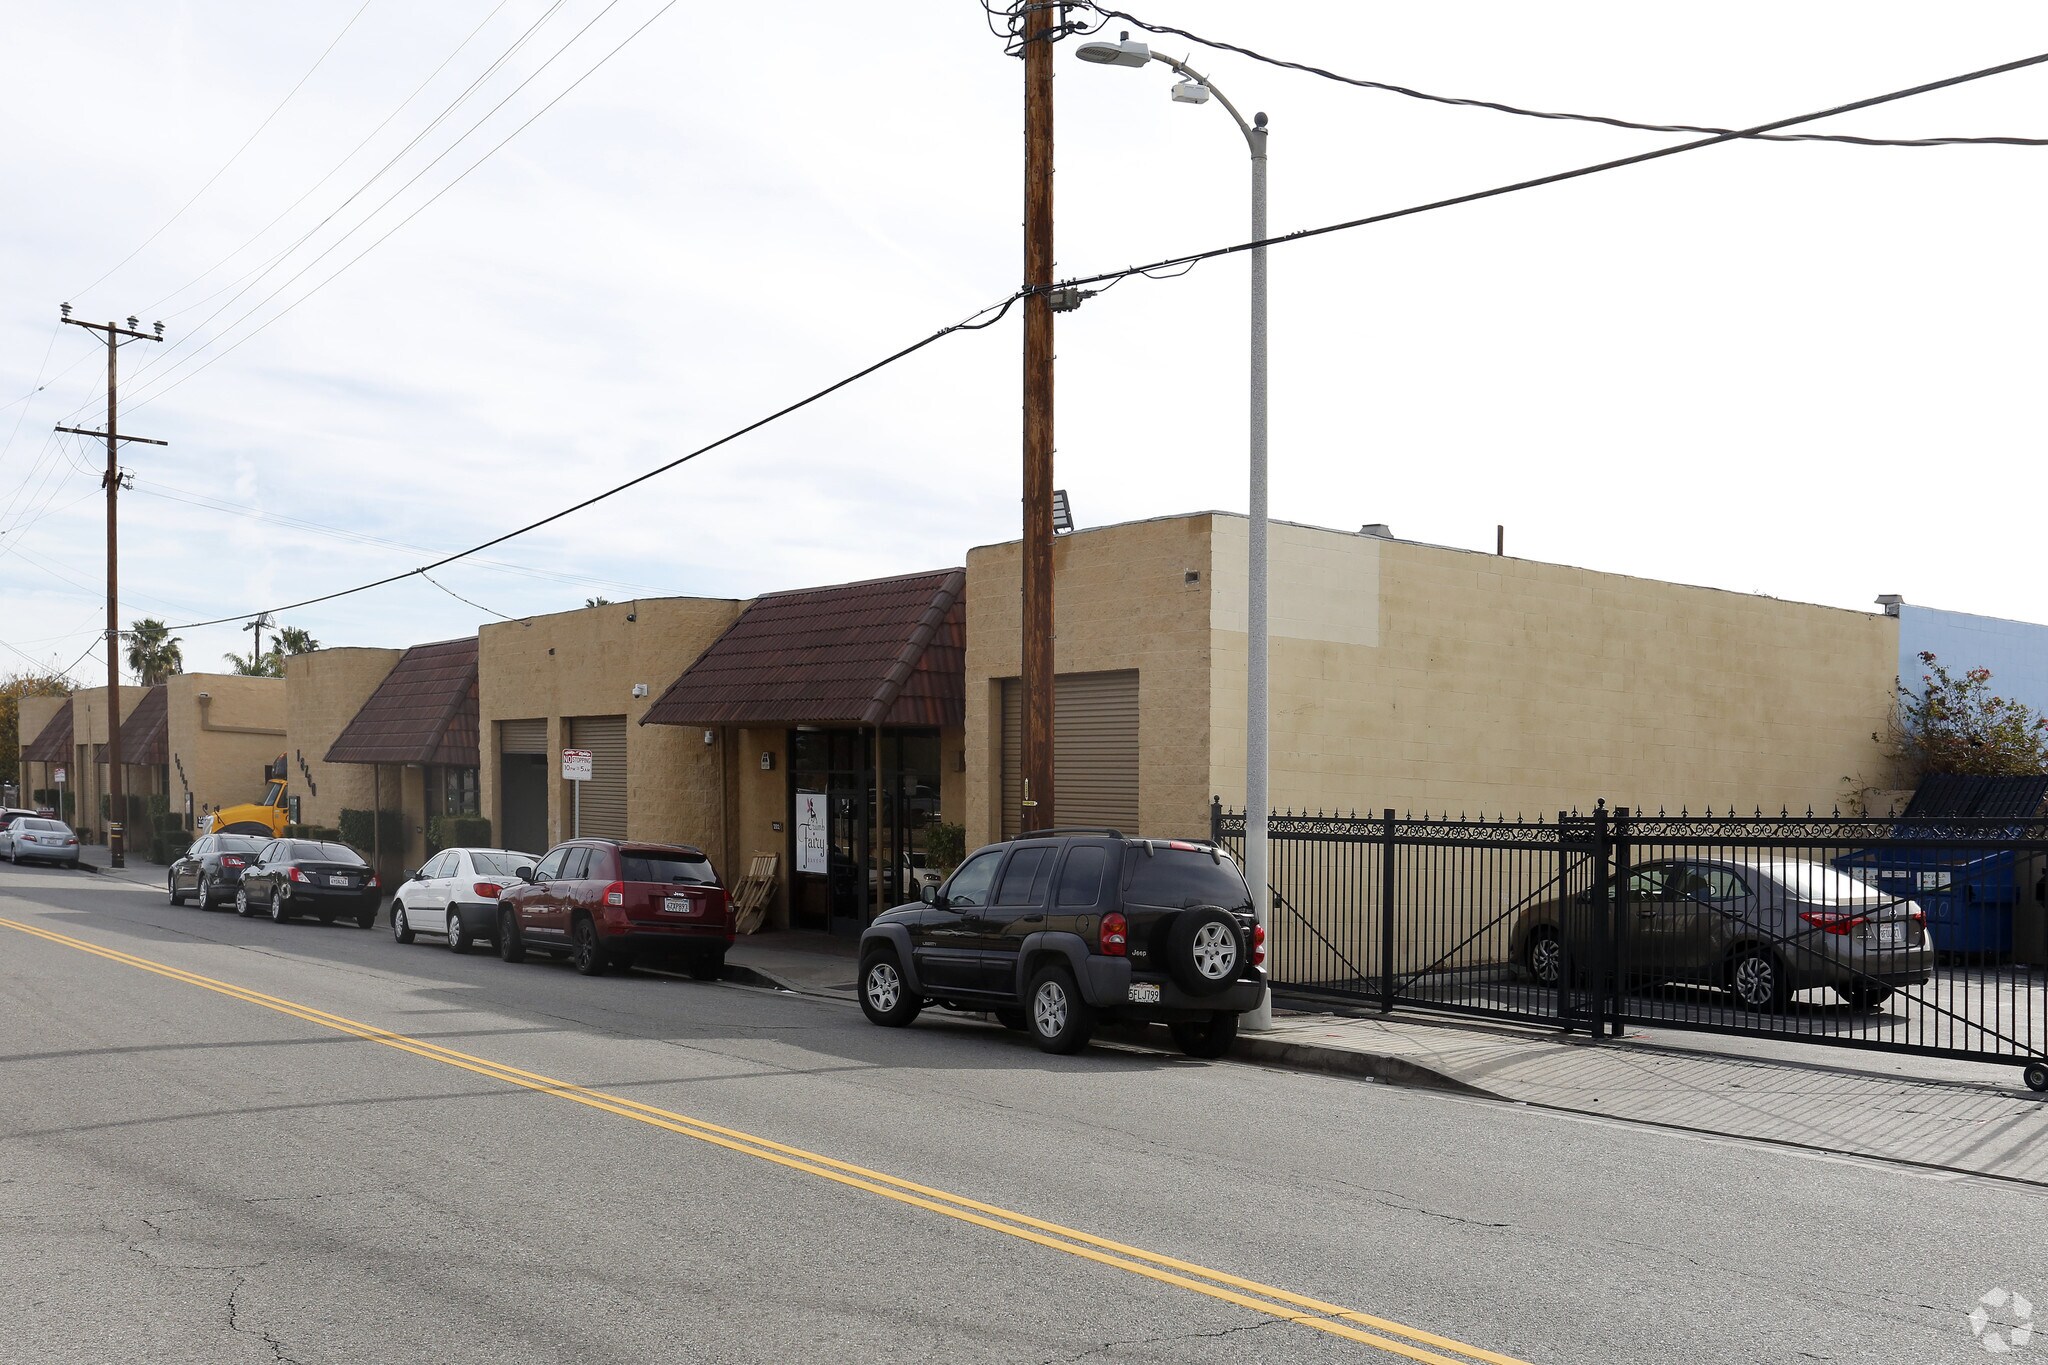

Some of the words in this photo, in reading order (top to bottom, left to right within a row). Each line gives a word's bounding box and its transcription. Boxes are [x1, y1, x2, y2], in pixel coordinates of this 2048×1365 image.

[563, 755, 572, 763] NO
[1131, 949, 1147, 957] Jeep
[1128, 989, 1159, 1001] 5FLJ799
